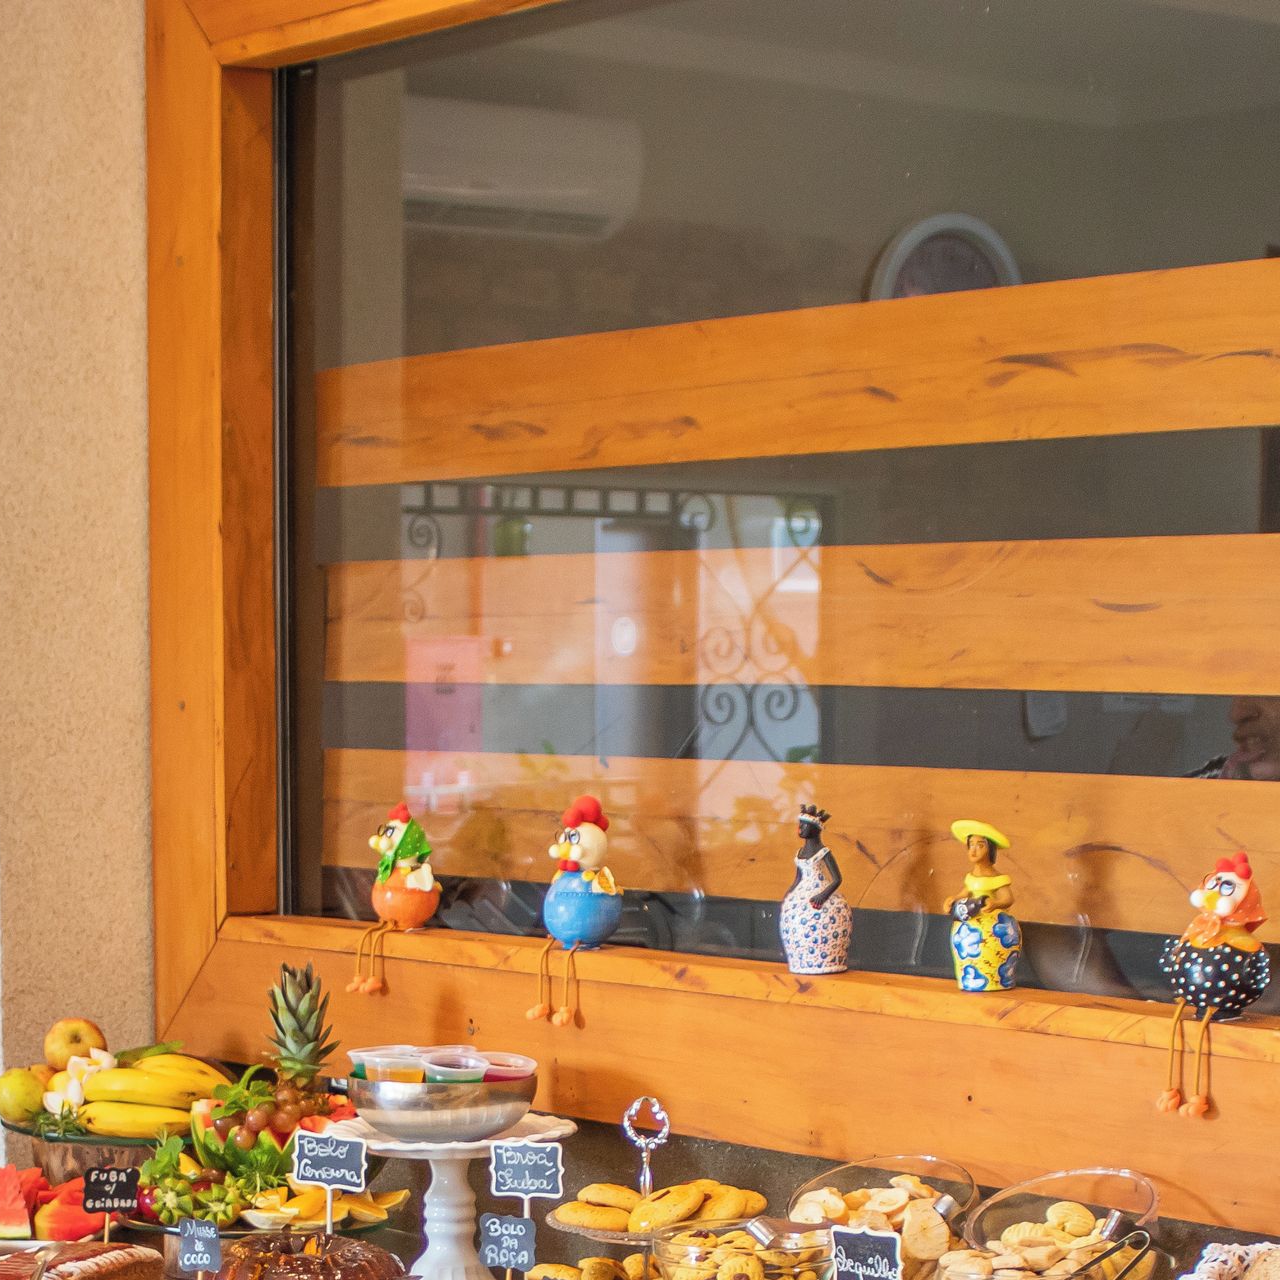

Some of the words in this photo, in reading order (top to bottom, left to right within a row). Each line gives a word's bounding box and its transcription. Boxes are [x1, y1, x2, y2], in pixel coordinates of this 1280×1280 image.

[299, 1136, 349, 1158] Bolo
[90, 1168, 132, 1182] FUBÁ
[299, 1158, 361, 1183] Cenoura
[485, 1218, 526, 1236] BOLO
